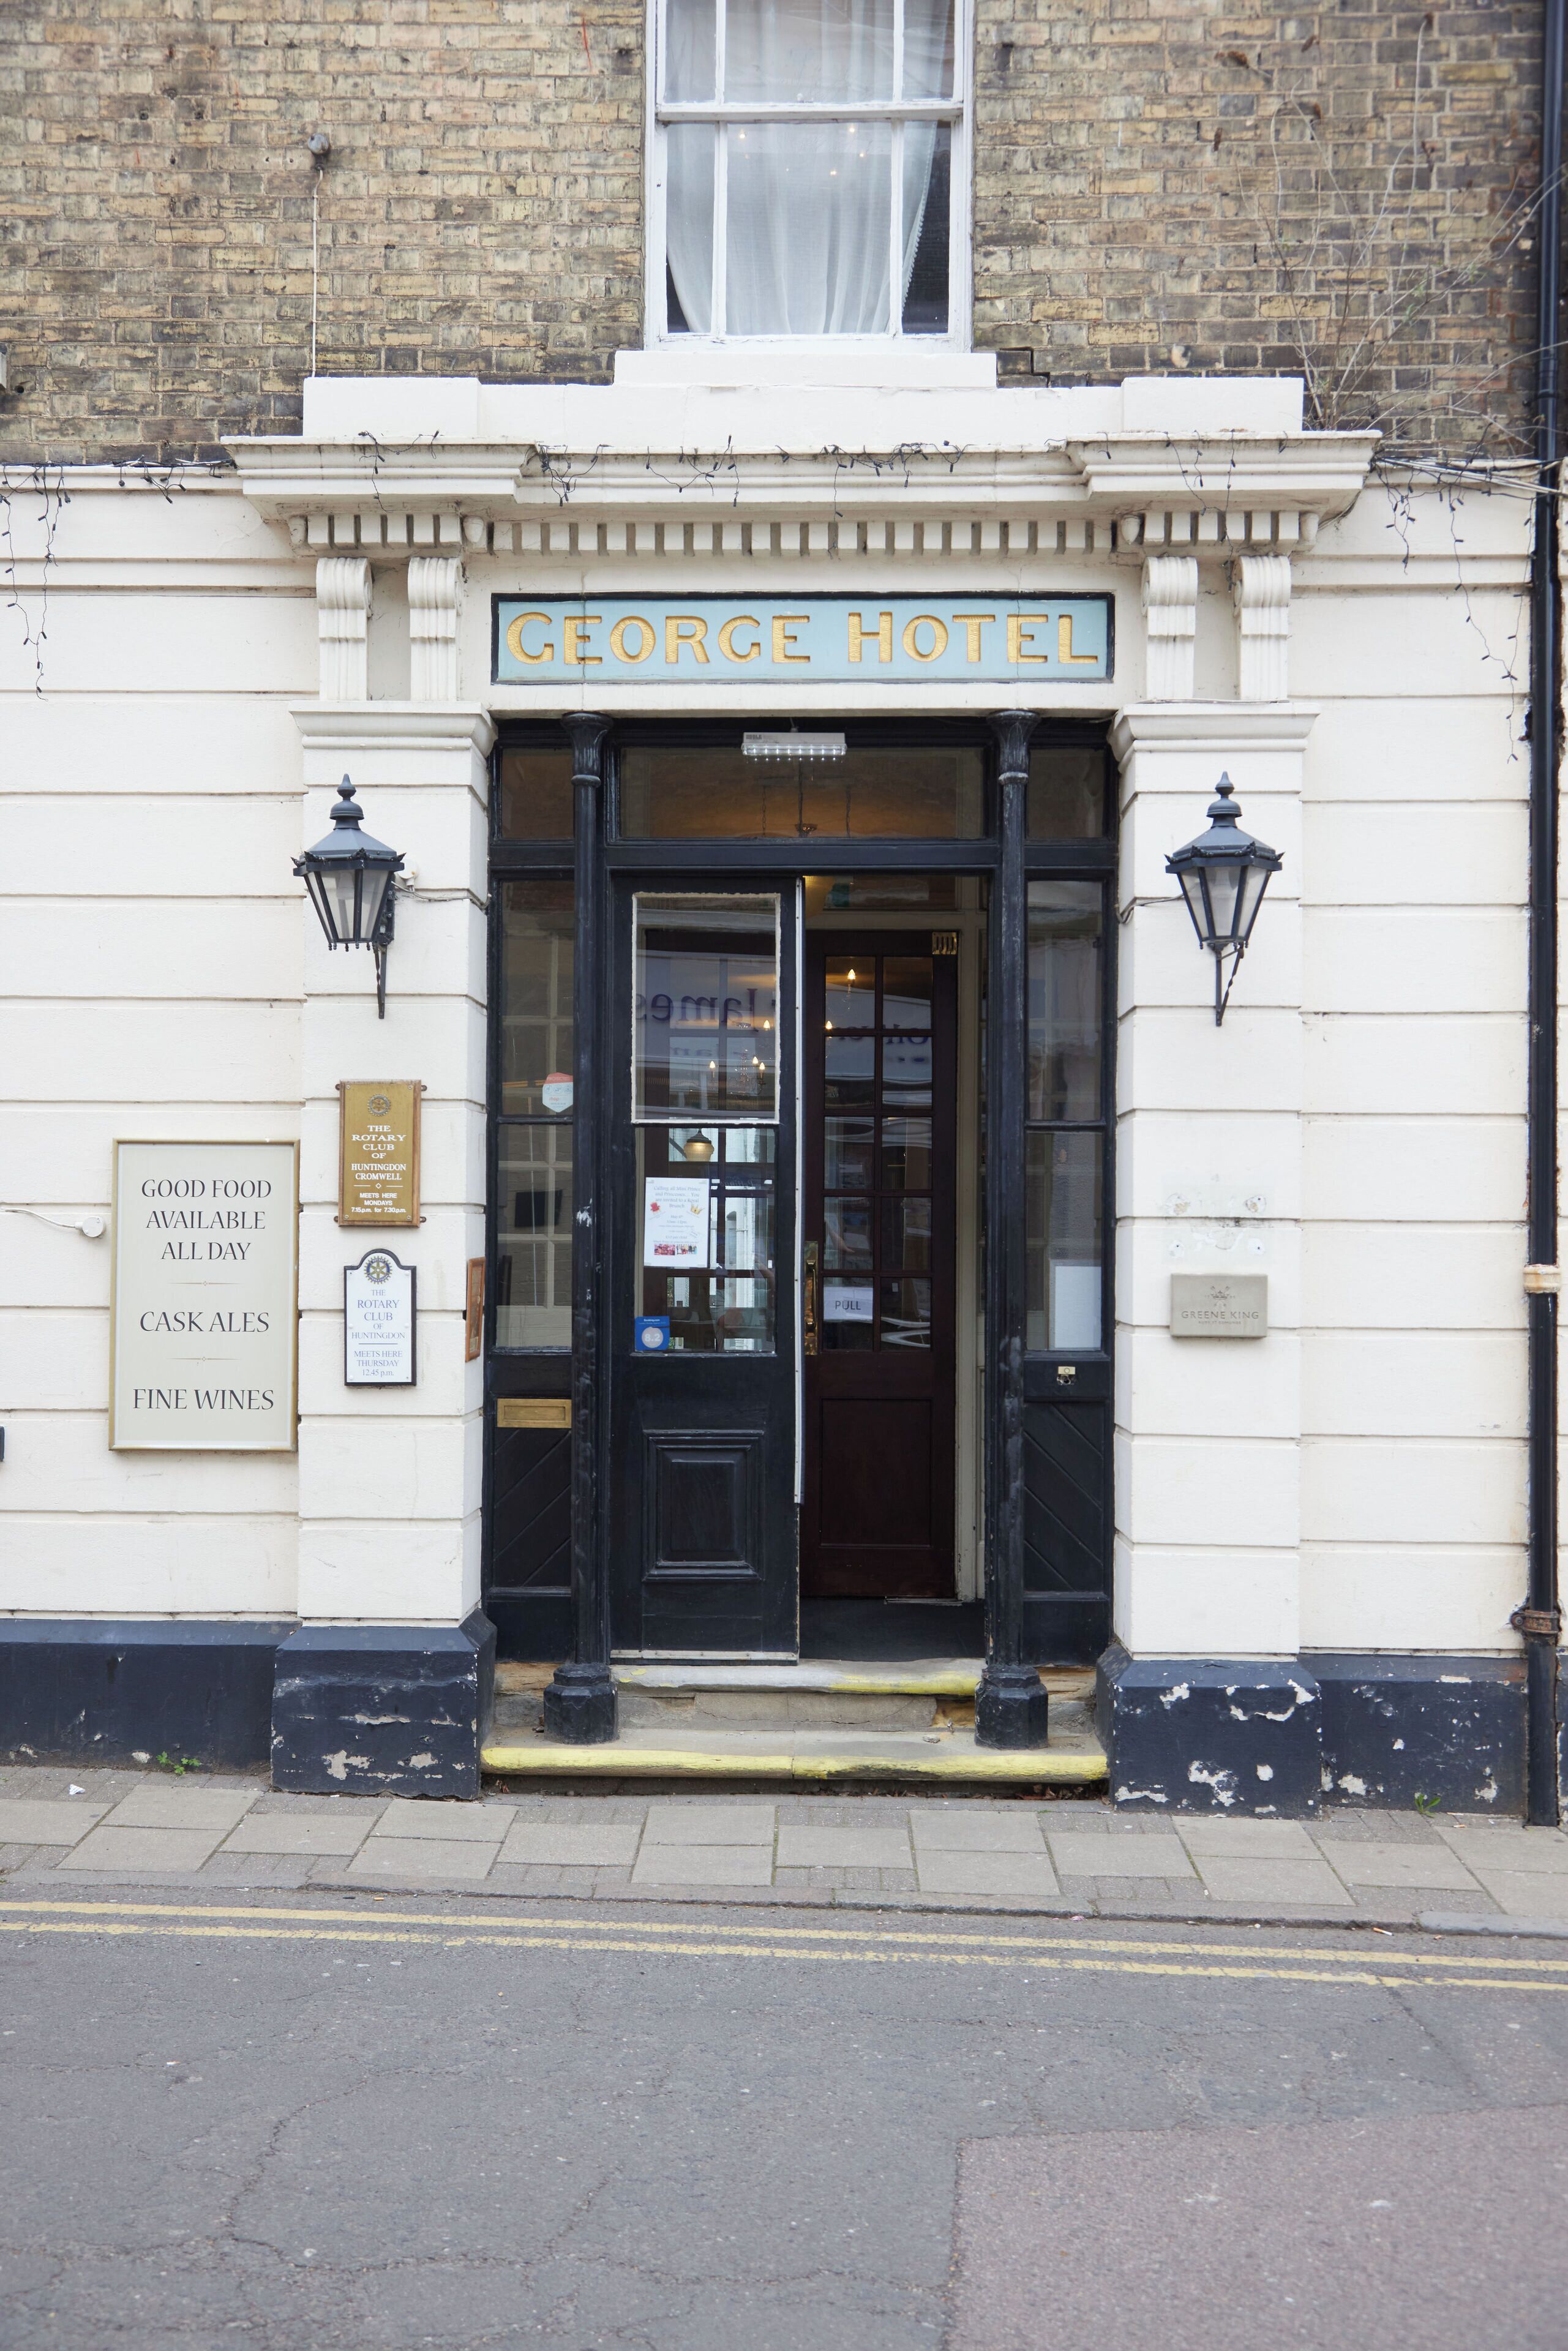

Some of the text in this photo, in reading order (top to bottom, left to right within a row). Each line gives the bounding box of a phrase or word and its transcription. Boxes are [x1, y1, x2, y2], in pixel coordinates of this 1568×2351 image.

[506, 611, 1098, 664] GEORGE HOTEL
[141, 1179, 271, 1198] GOOD FOOD
[146, 1210, 266, 1229] AVAILABLE
[160, 1242, 252, 1260] ALL DAY
[358, 1300, 400, 1308] ROTARY
[835, 1300, 861, 1310] PULL
[140, 1311, 269, 1333] CASK ALES
[364, 1312, 393, 1321] CLUB
[133, 1388, 274, 1411] FINE WINES
